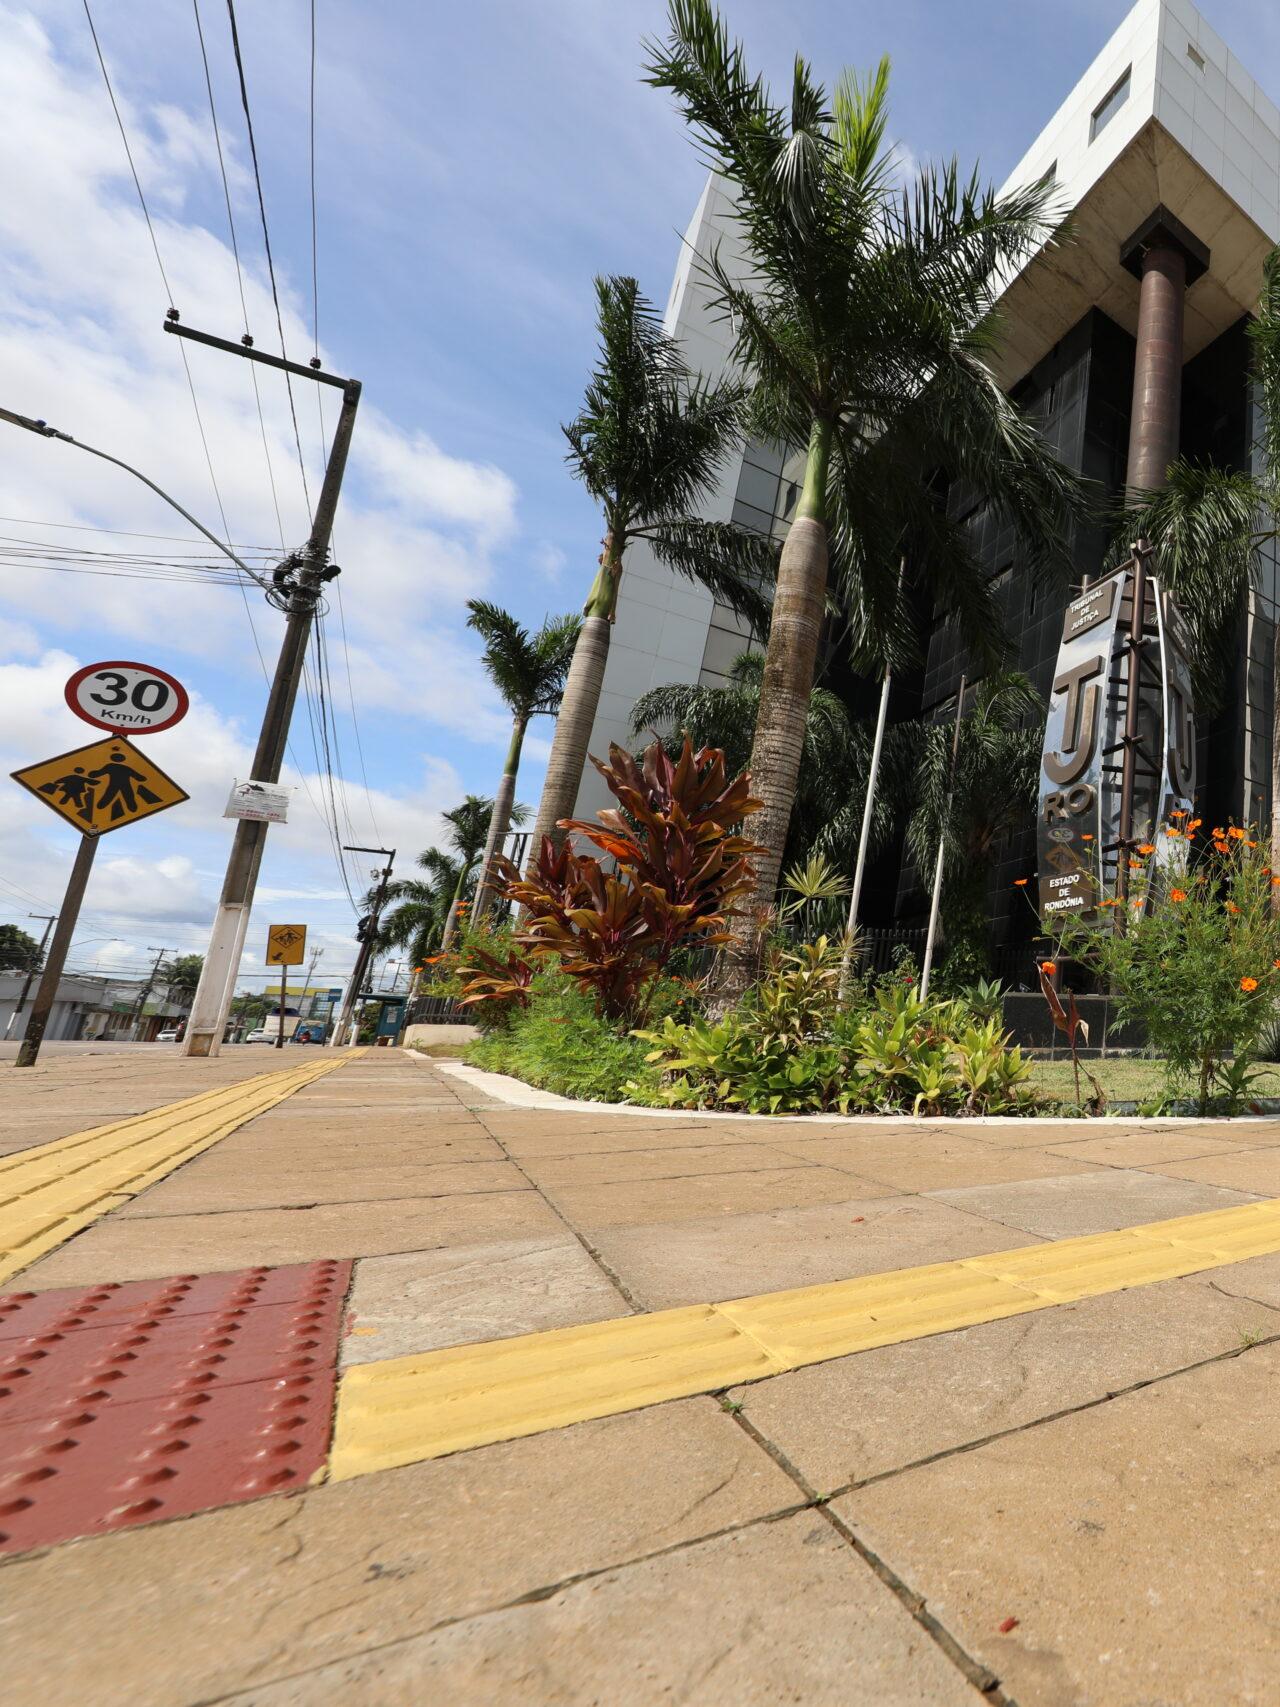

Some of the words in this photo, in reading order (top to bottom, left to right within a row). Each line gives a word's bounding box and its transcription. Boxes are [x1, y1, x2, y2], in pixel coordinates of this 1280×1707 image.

[1071, 590, 1104, 613] TRIBUNAL
[1081, 605, 1090, 616] DE
[1071, 609, 1099, 631] JUSTIÇA
[90, 672, 169, 712] 30
[101, 709, 151, 725] Km/h
[1043, 655, 1105, 786] TJ
[1043, 783, 1095, 824] RO
[1049, 874, 1080, 888] ESTADO
[1059, 887, 1070, 897] DE
[1044, 896, 1084, 911] RONDÔNIA
